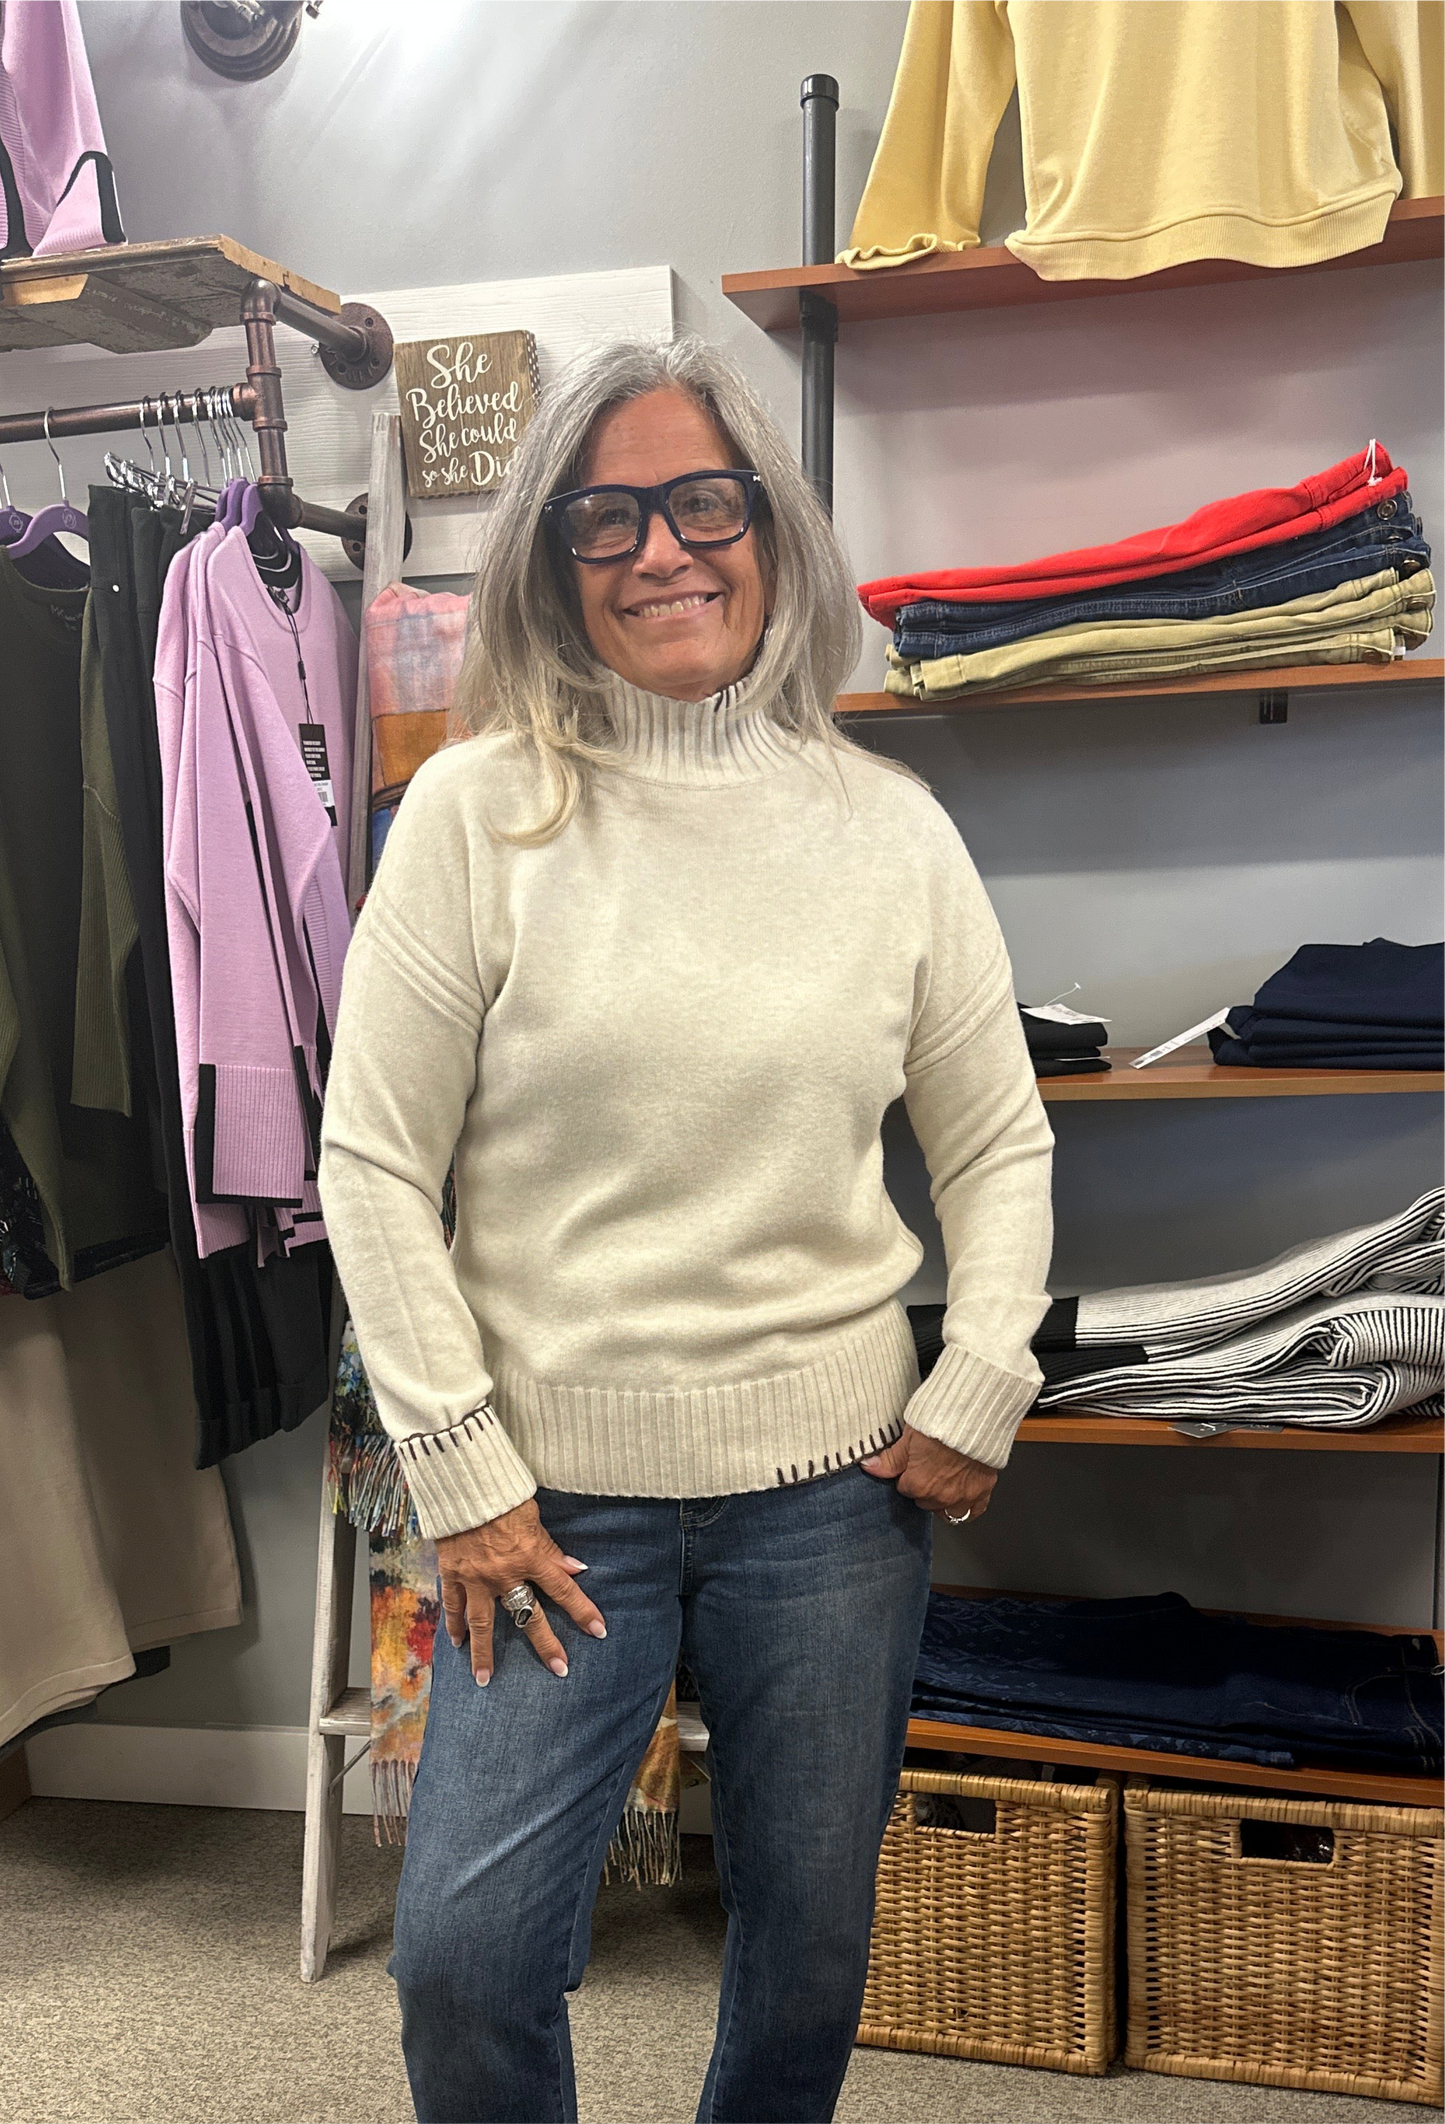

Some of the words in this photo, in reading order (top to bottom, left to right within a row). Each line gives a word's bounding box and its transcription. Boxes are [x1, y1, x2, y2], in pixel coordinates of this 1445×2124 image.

[426, 341, 493, 389] She
[405, 381, 524, 429] Believed
[419, 423, 460, 464] She
[461, 412, 519, 447] could
[422, 470, 441, 488] so
[440, 457, 468, 486] she
